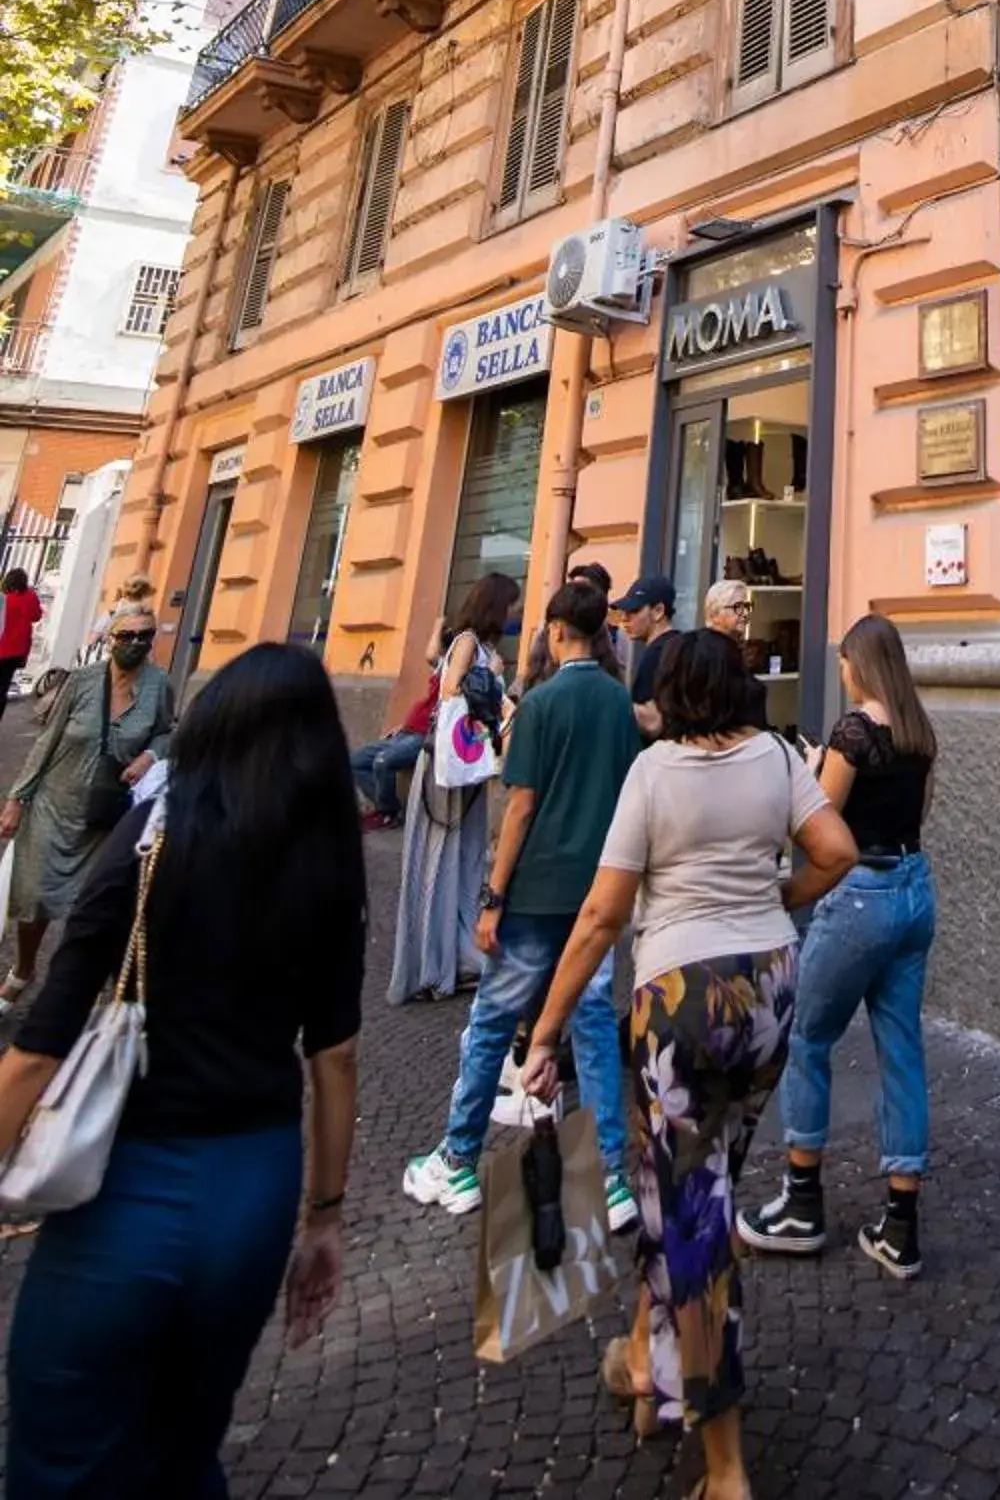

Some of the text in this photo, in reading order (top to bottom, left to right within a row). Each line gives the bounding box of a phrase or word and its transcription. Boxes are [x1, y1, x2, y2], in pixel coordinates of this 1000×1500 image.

[476, 300, 545, 347] BANCA
[475, 338, 539, 383] SELLA
[317, 364, 363, 400] BANCA
[315, 397, 355, 429] SELLA
